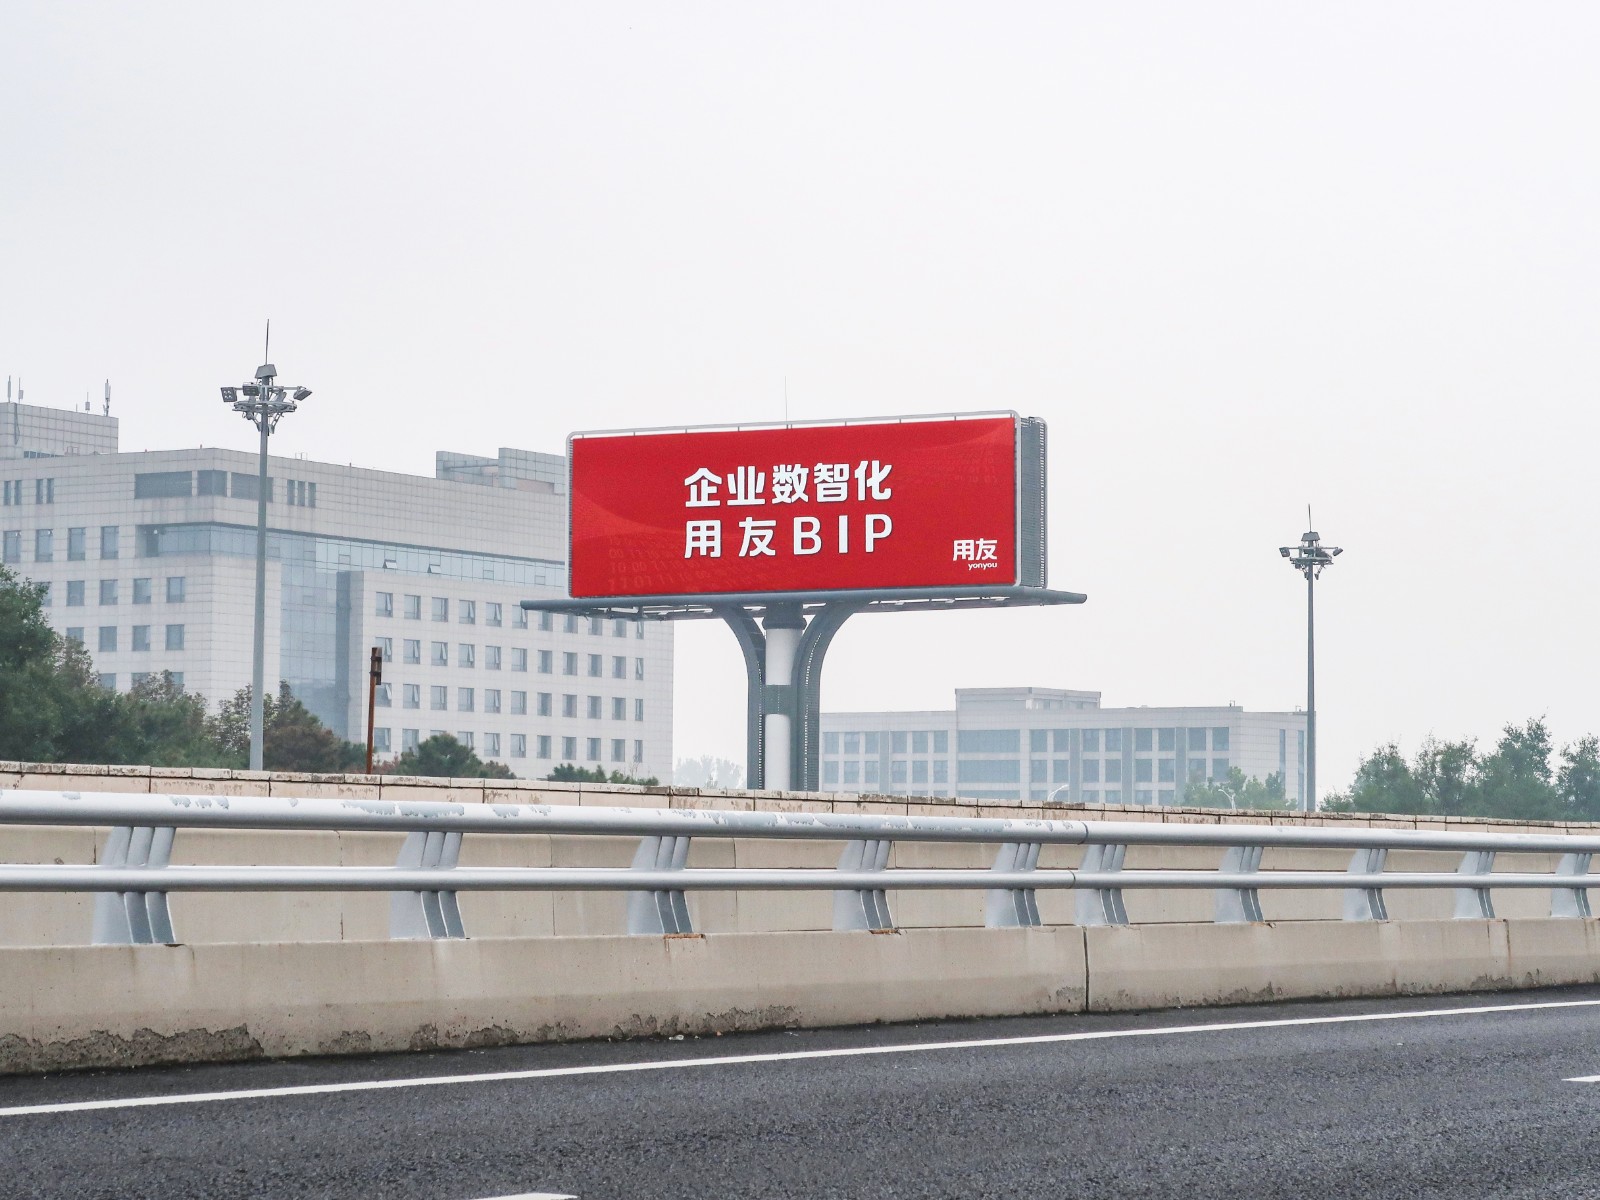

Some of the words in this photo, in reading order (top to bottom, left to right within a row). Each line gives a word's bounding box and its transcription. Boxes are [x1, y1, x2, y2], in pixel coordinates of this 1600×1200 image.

[684, 460, 893, 507] 企业数智化
[952, 538, 998, 562] 用友
[967, 562, 998, 571] yonyou
